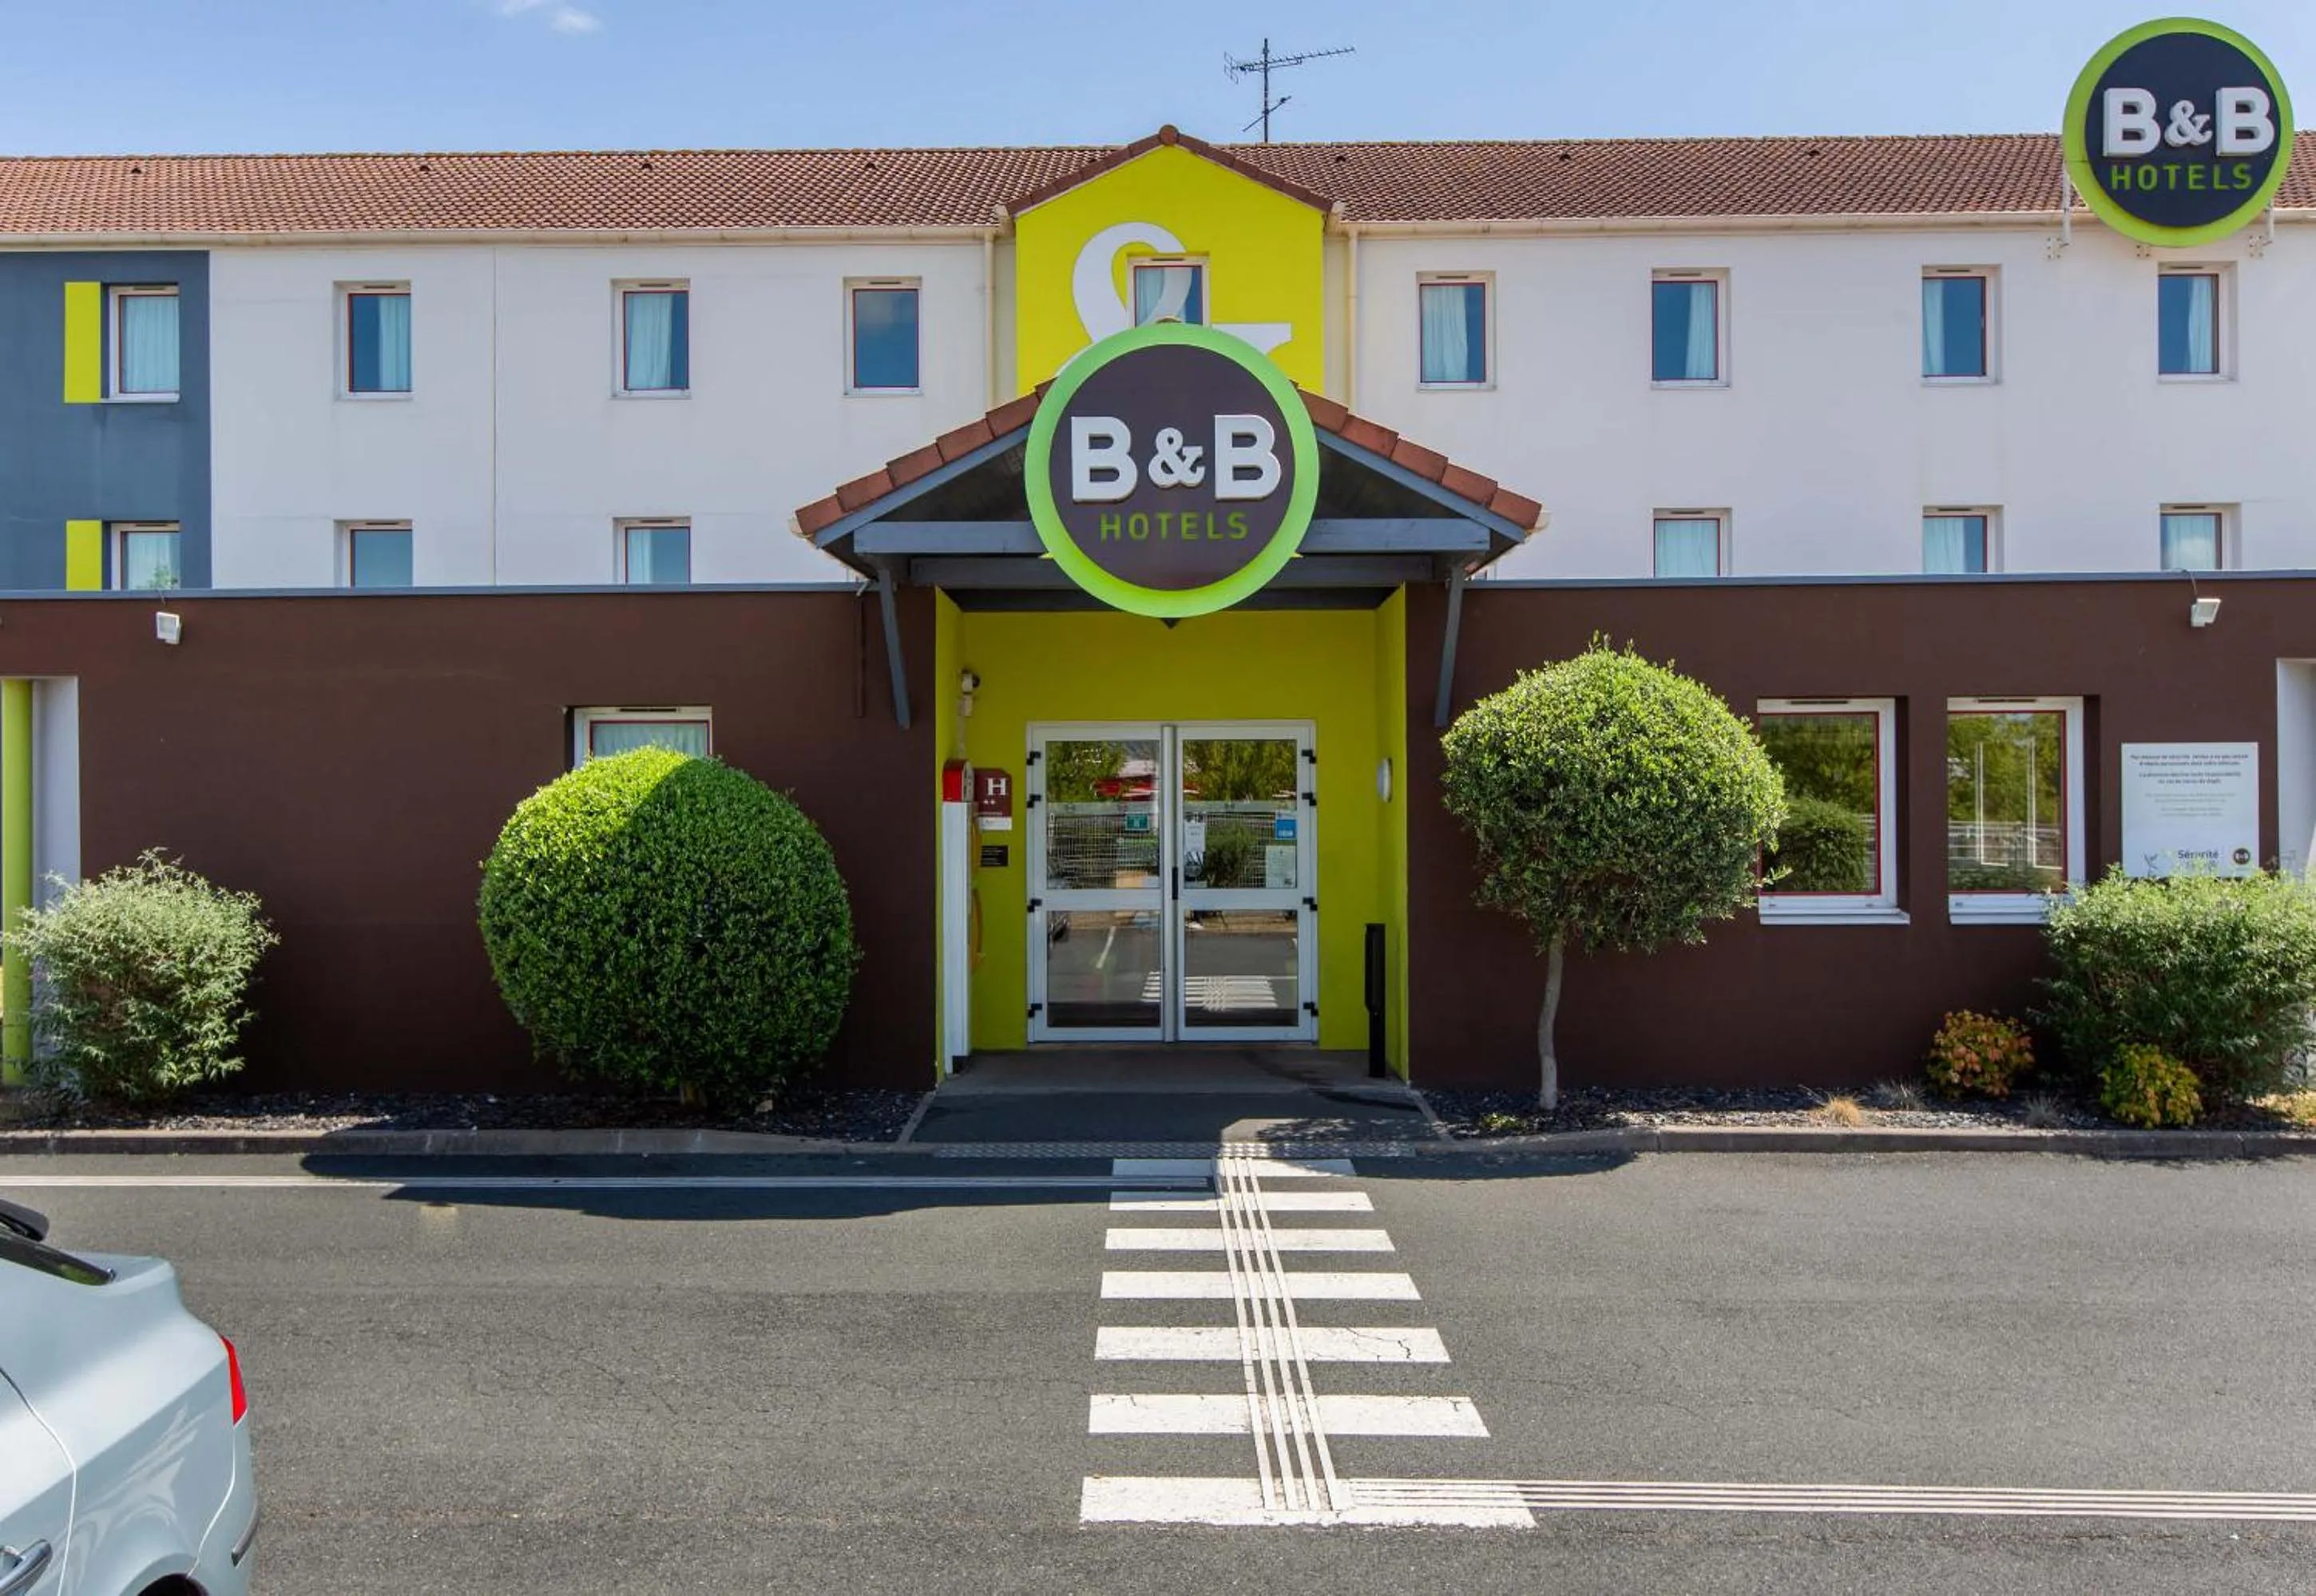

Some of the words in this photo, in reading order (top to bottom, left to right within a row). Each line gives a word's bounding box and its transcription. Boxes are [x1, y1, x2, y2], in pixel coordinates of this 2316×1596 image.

[2102, 86, 2274, 157] B&B
[2110, 163, 2253, 191] HOTELS
[1070, 414, 1283, 503] B&B
[1099, 512, 1250, 542] HOTELS
[986, 777, 1007, 796] H
